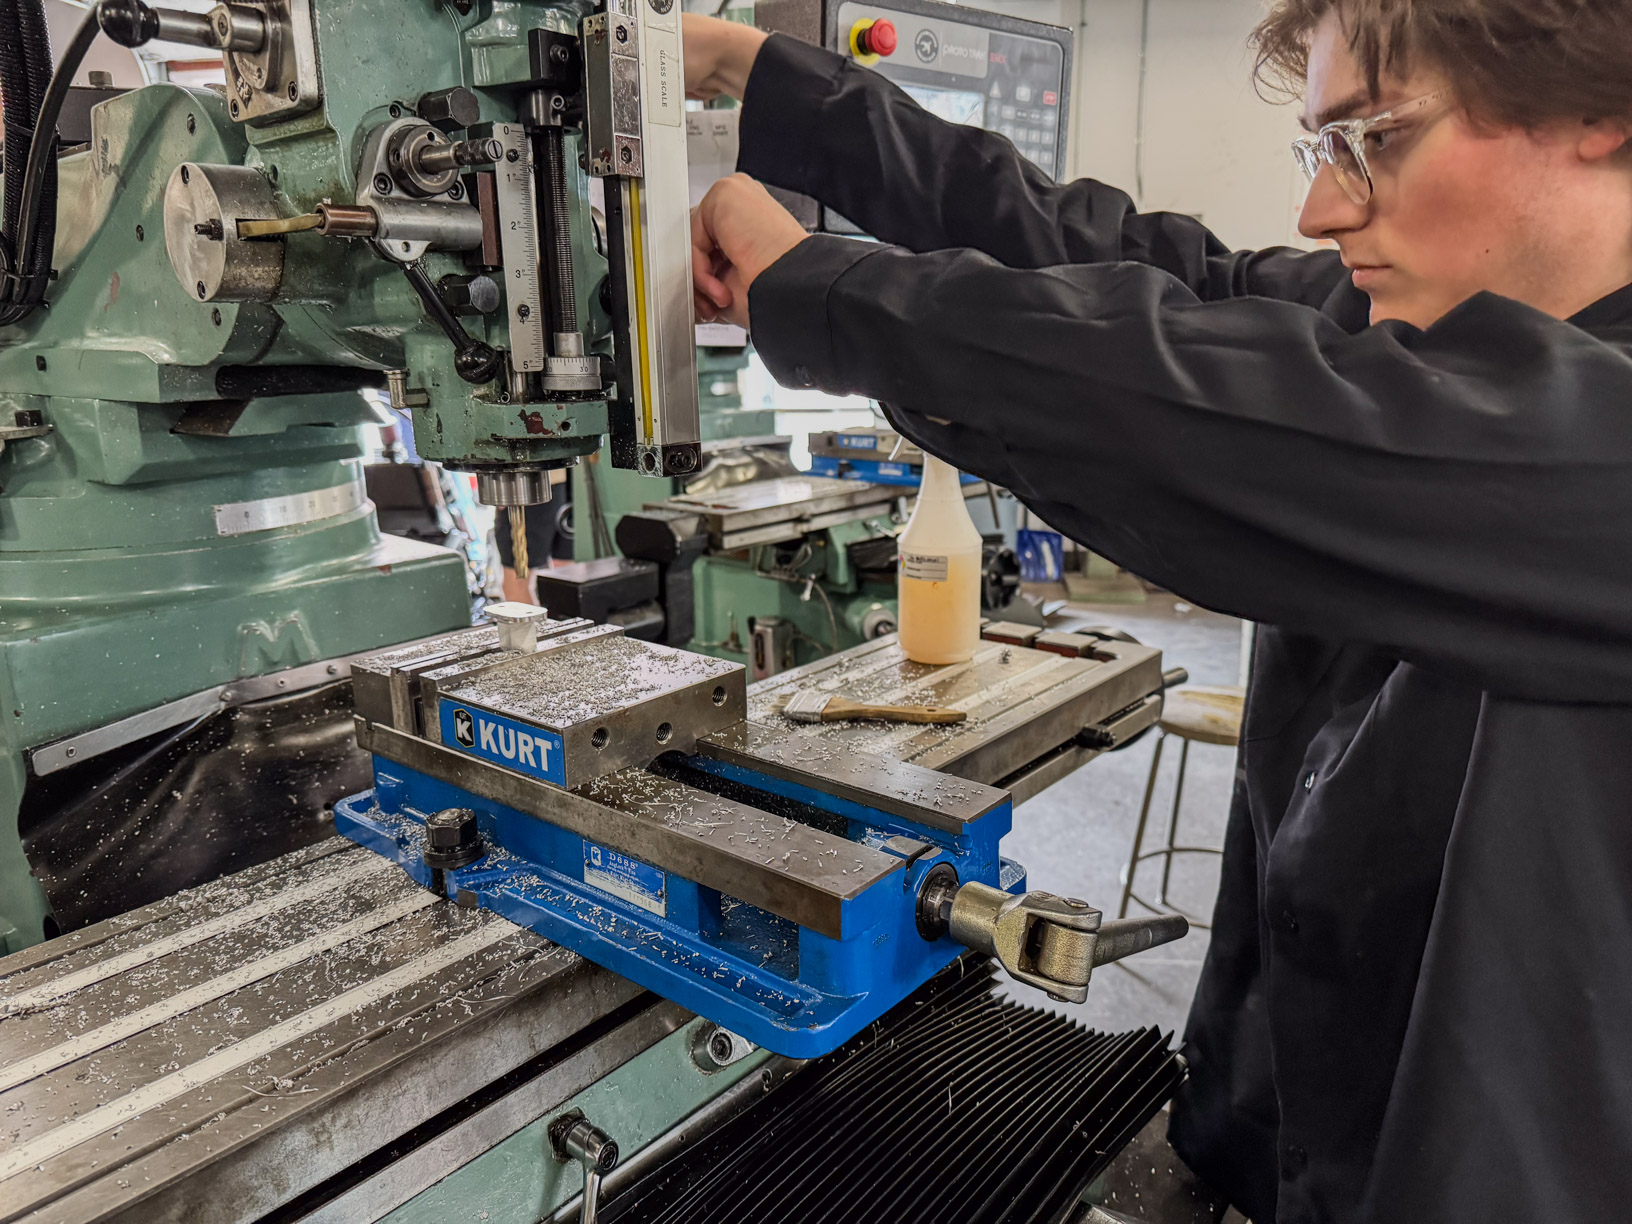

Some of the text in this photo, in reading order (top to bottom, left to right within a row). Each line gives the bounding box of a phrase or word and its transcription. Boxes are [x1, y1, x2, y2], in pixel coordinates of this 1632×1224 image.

[659, 49, 667, 78] GLASS
[503, 125, 510, 135] 0
[510, 221, 517, 231] 2
[515, 269, 521, 279] 3
[523, 360, 529, 370] 5
[478, 718, 553, 773] KURT
